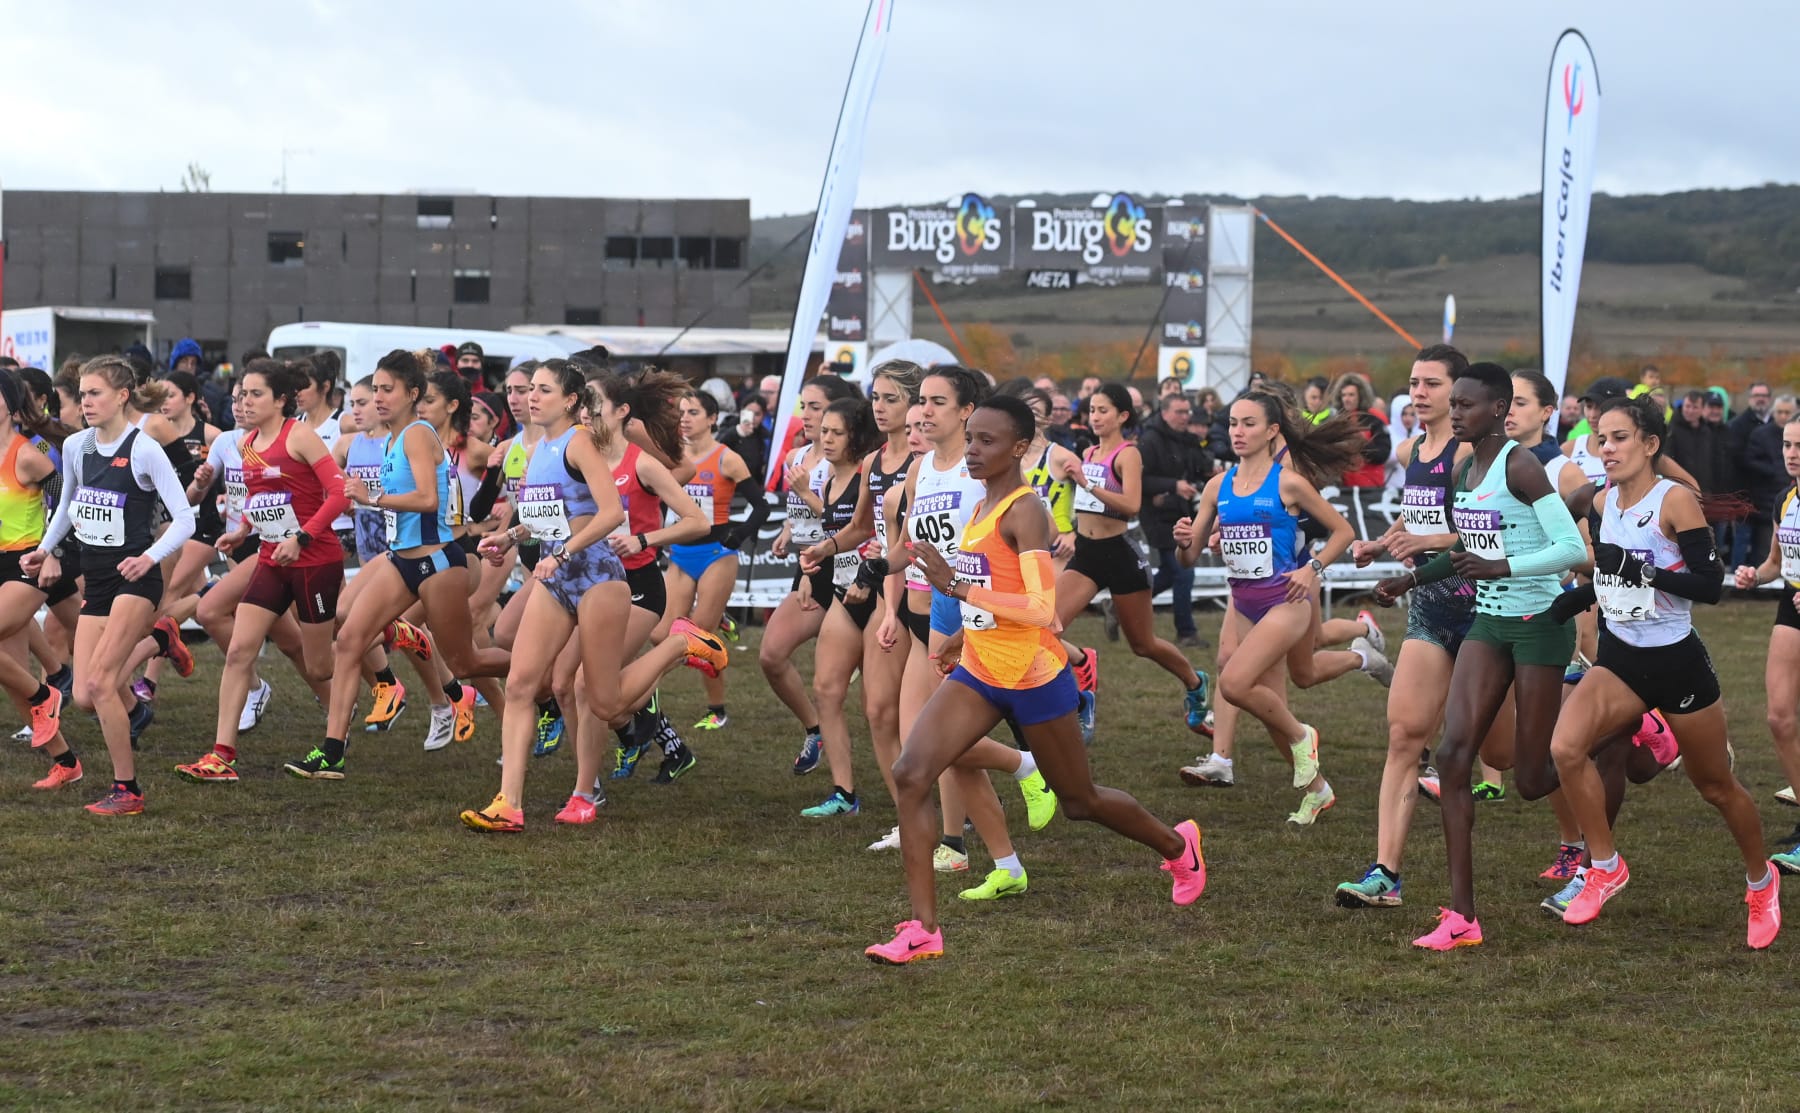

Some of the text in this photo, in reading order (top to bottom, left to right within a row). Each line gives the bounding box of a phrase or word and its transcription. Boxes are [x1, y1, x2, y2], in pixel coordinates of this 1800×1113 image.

[1032, 192, 1152, 264] Burgos
[1549, 148, 1572, 292] iberCaja
[887, 193, 1001, 264] Burgos
[1027, 272, 1072, 288] META
[76, 505, 112, 522] KEITH
[250, 507, 286, 523] MASIP
[522, 504, 560, 519] GALLARDO
[1402, 508, 1443, 525] SANCHEZ
[915, 512, 955, 544] 405
[1222, 524, 1263, 533] DIPUTACIÓN
[1223, 531, 1265, 539] BURGOS
[1223, 541, 1268, 556] CASTRO
